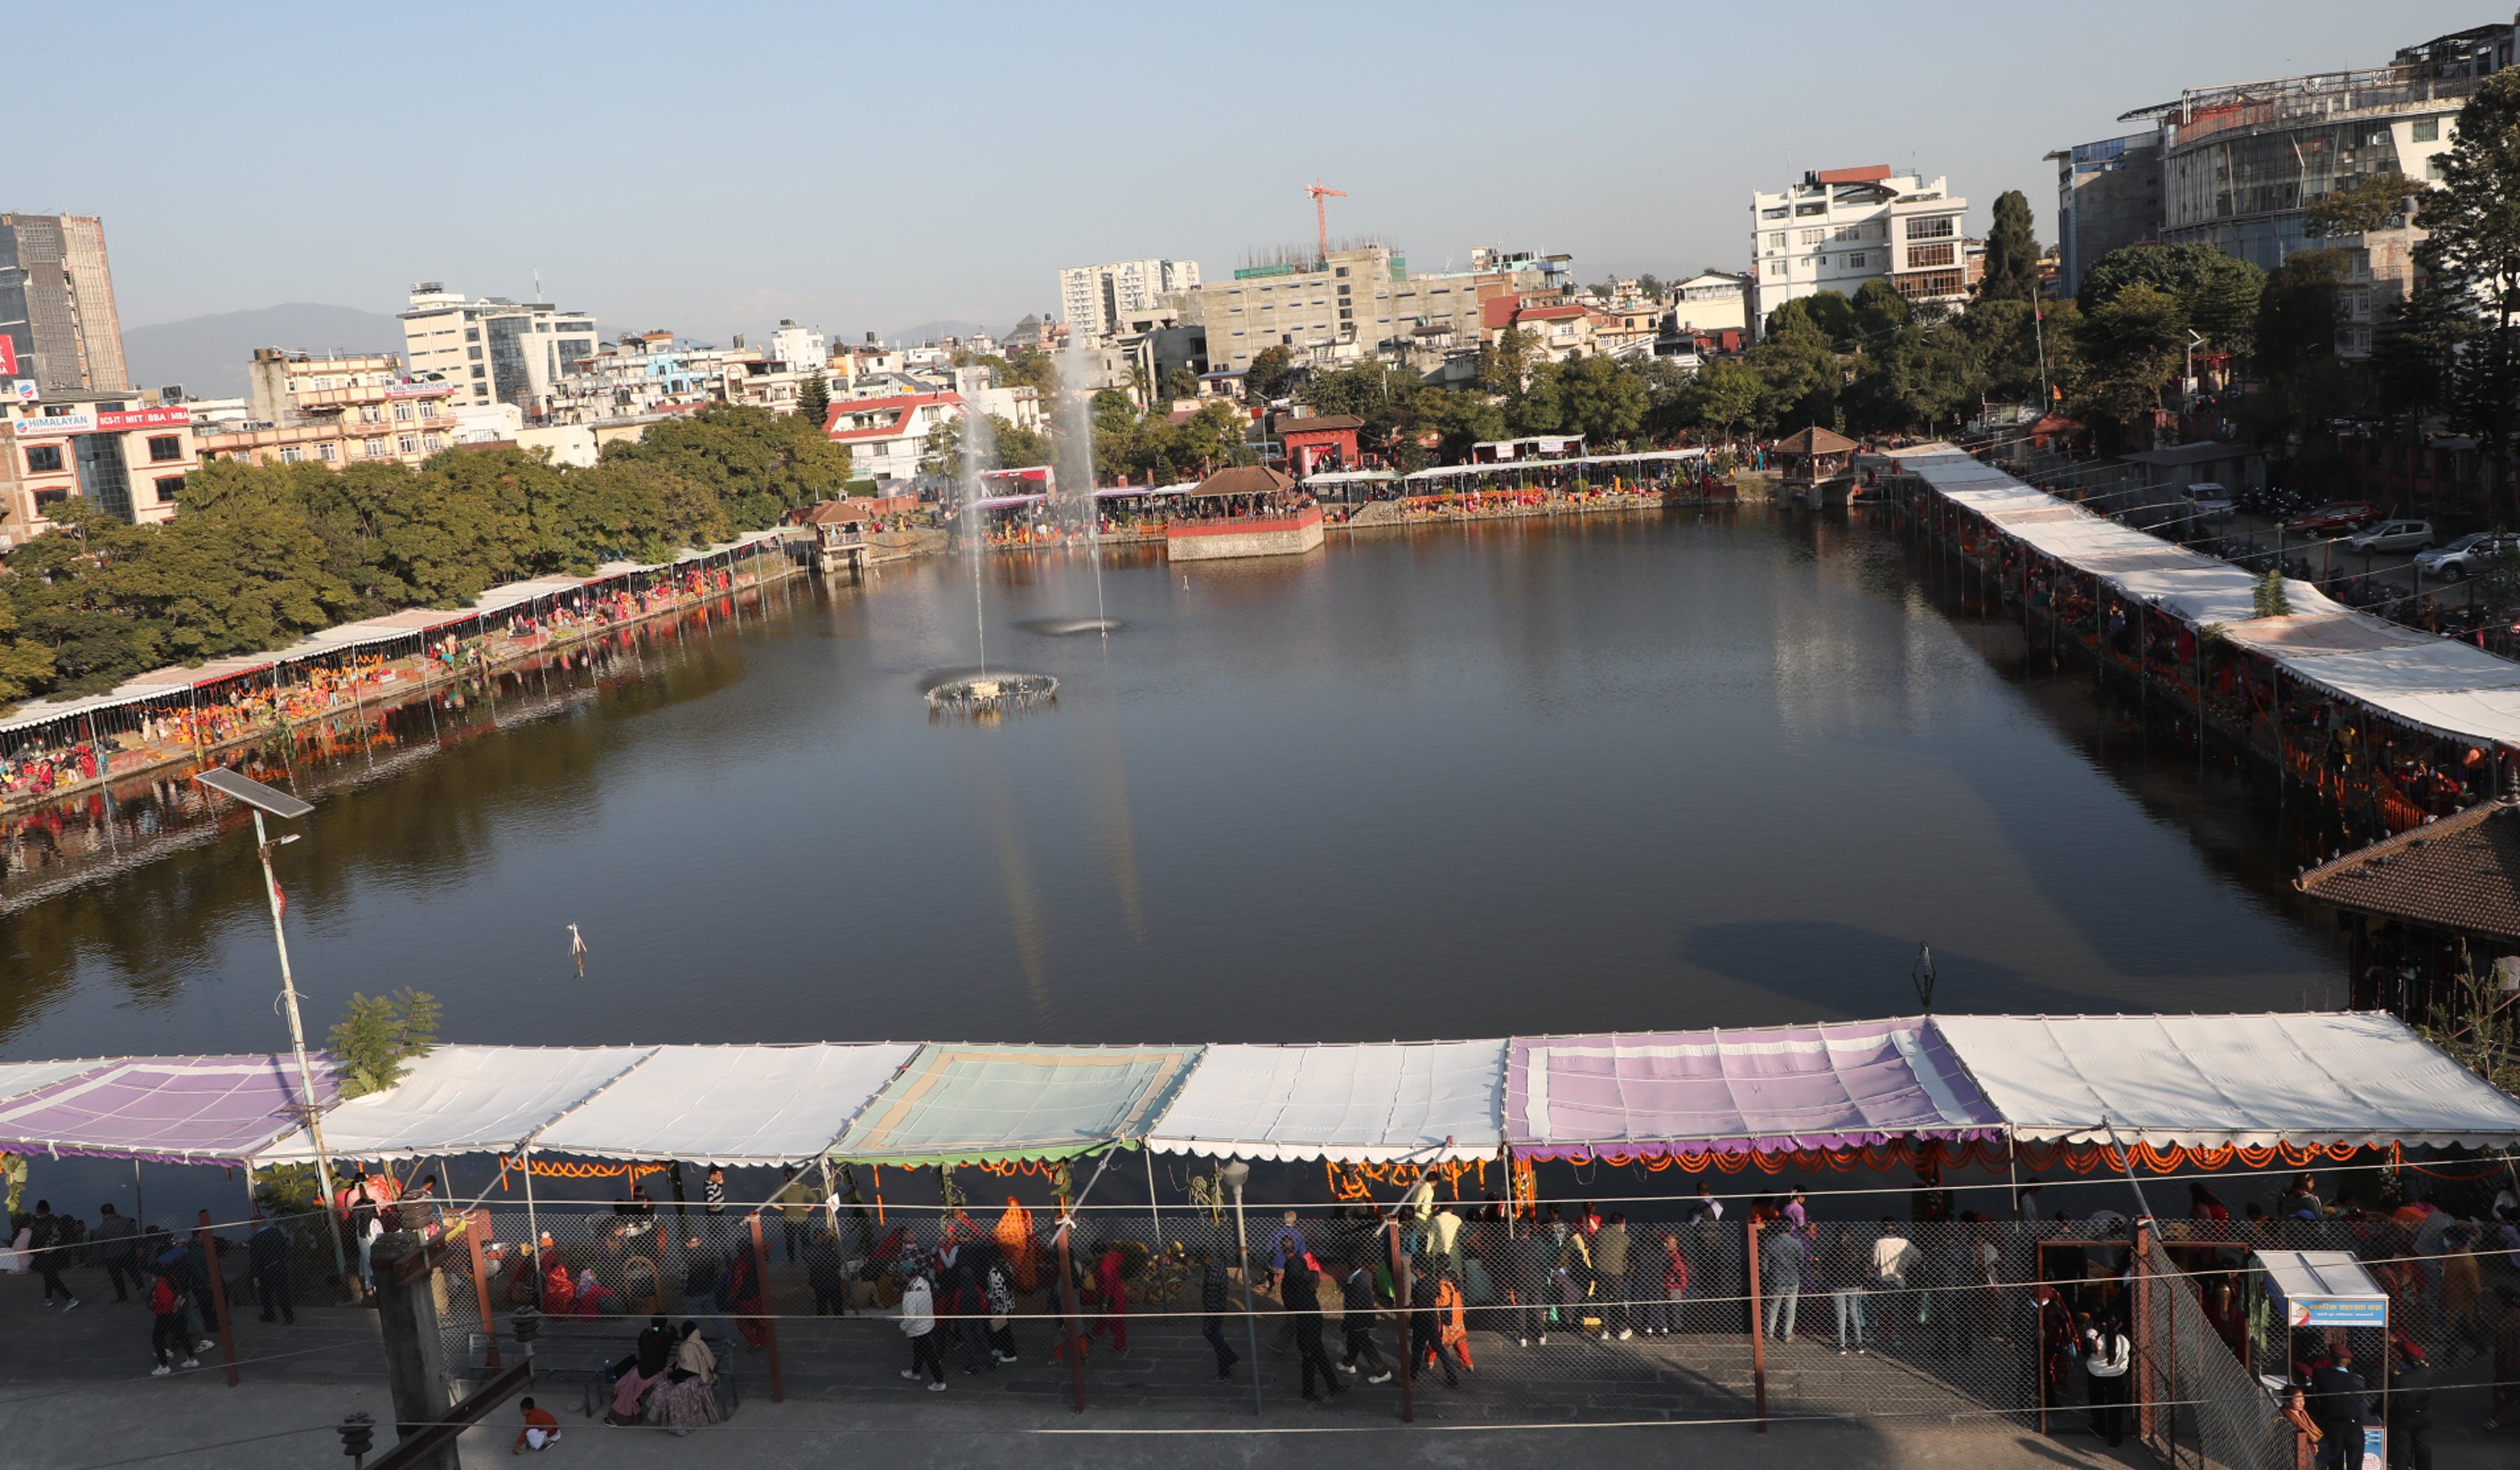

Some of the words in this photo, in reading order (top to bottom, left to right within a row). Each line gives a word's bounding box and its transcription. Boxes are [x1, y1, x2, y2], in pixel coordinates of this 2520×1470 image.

[29, 416, 88, 427] HIMALAYAN
[126, 414, 144, 424] MIT
[148, 413, 167, 421] BBA
[171, 412, 190, 420] MBA
